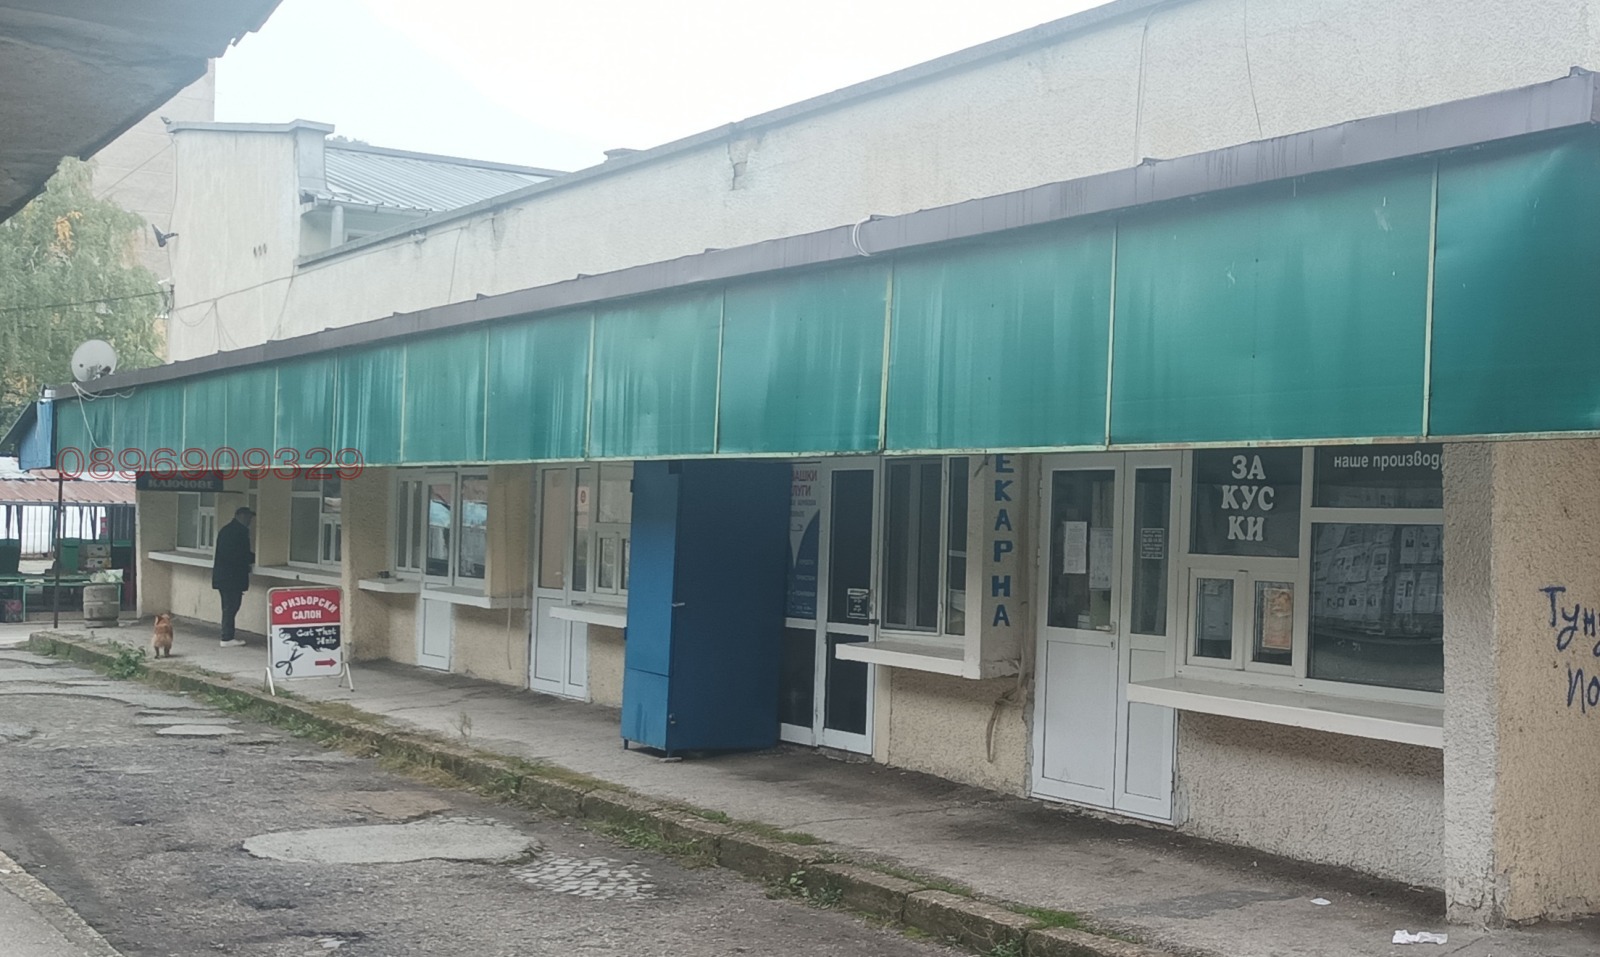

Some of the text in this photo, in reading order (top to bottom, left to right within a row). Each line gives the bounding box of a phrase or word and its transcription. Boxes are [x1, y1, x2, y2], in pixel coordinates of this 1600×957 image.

[1231, 454, 1267, 480] ЗА
[1333, 455, 1369, 468] наше
[148, 479, 214, 489] КЛЮЧОВЕ
[1221, 484, 1275, 511] КУС
[1227, 515, 1265, 541] КИ
[274, 596, 338, 615] ФРИЗЬОРСКИ
[292, 610, 322, 620] САЛОН
